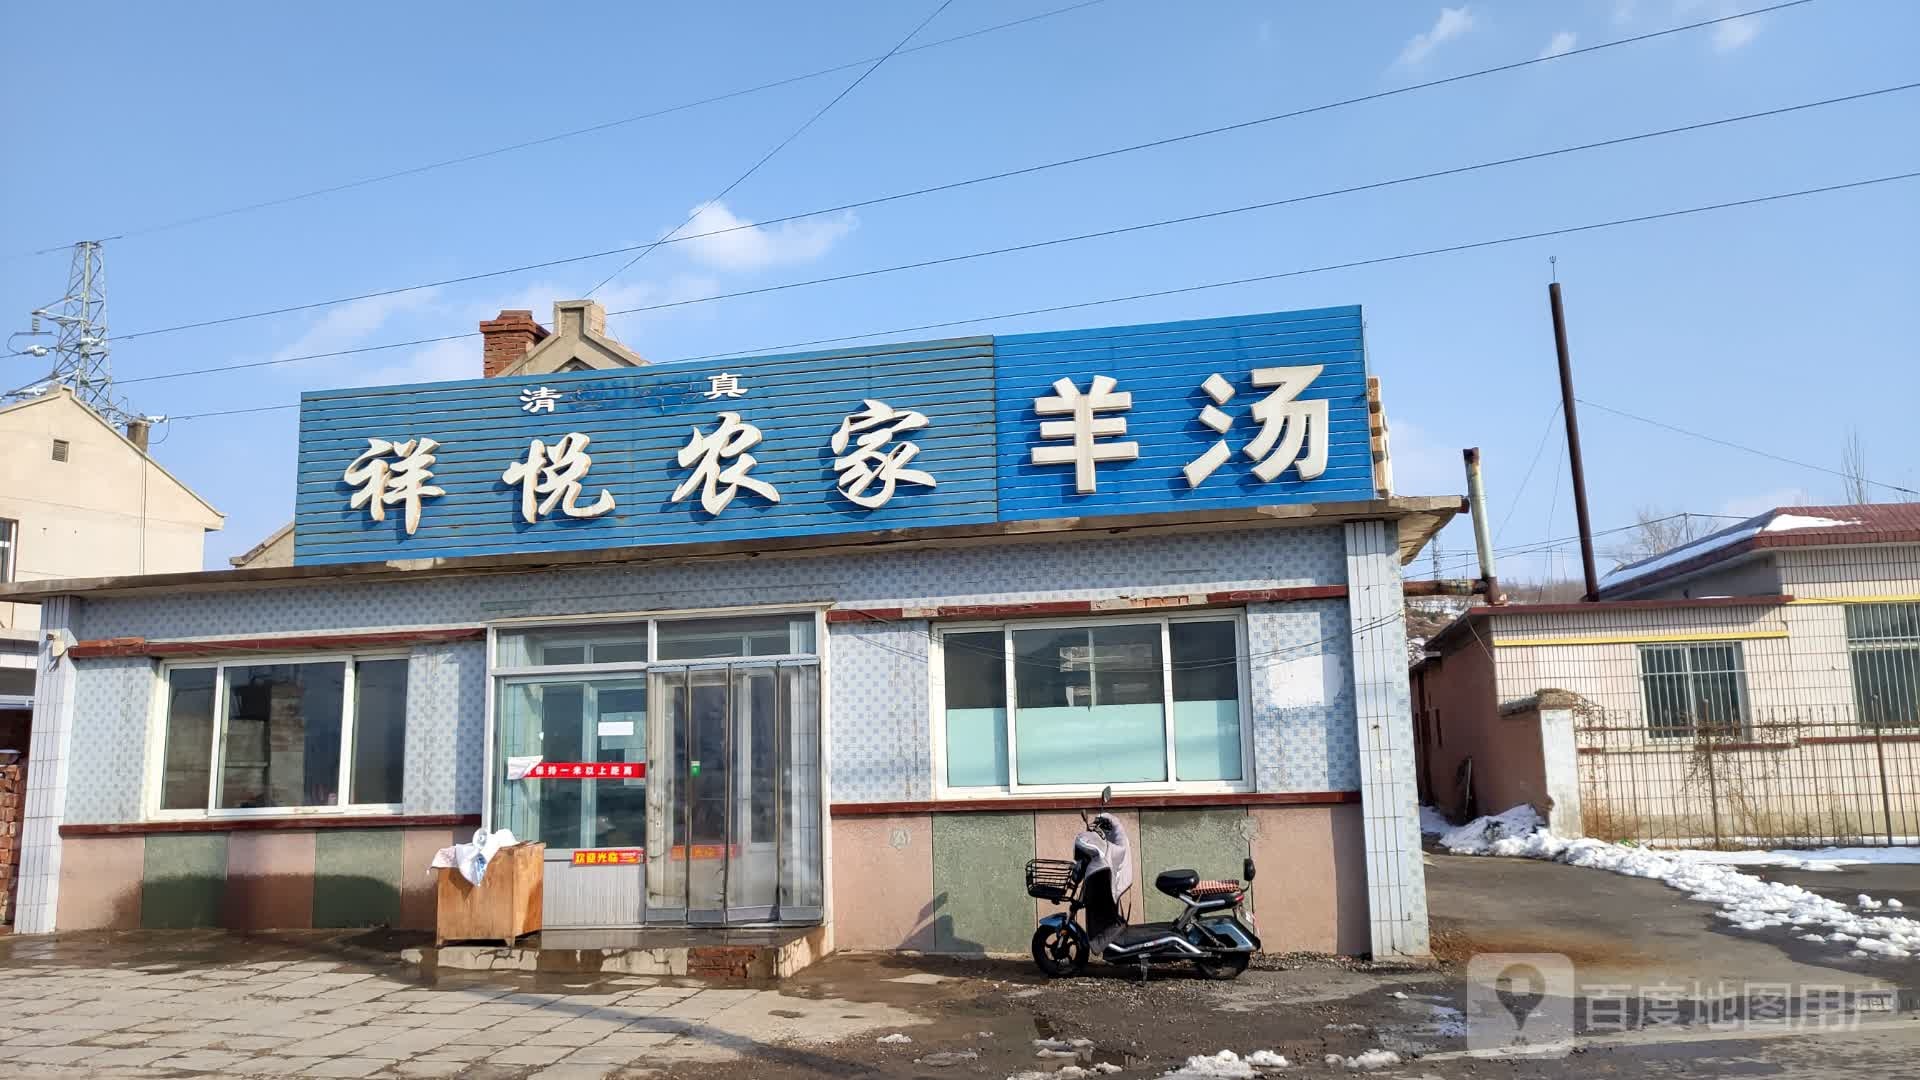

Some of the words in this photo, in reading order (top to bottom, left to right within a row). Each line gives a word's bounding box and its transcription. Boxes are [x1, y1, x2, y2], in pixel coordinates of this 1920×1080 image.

[525, 765, 633, 776] 保持一米以上距离
